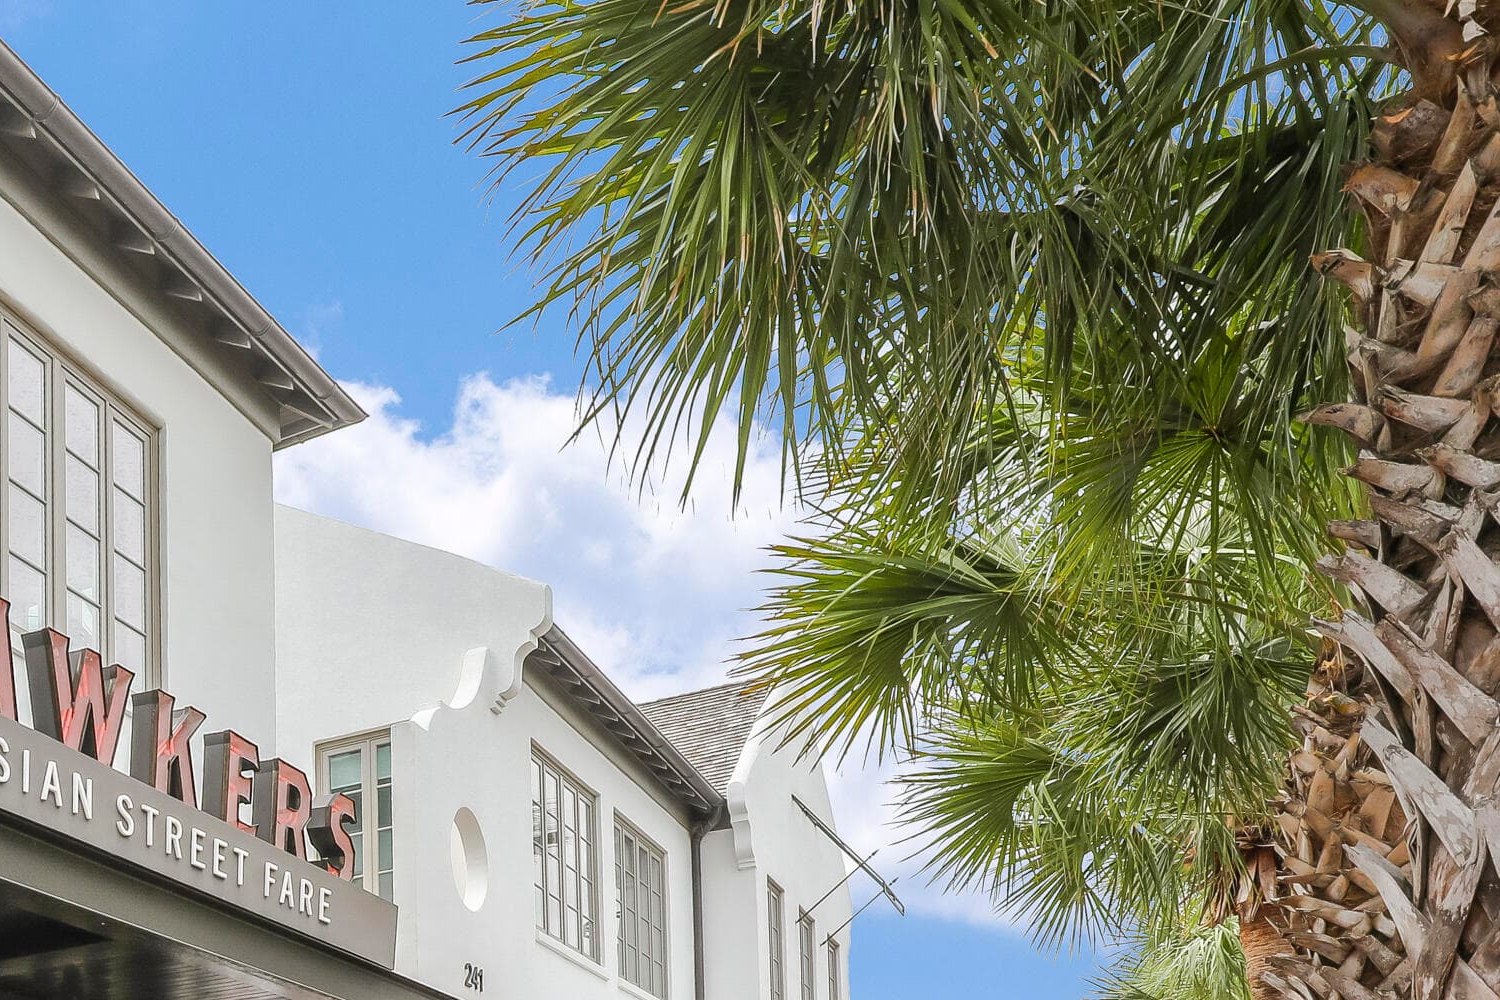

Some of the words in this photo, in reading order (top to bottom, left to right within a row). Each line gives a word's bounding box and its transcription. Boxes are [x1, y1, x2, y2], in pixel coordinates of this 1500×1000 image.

[115, 794, 249, 886] STREET
[263, 861, 333, 924] FARE
[464, 962, 483, 992] 241
